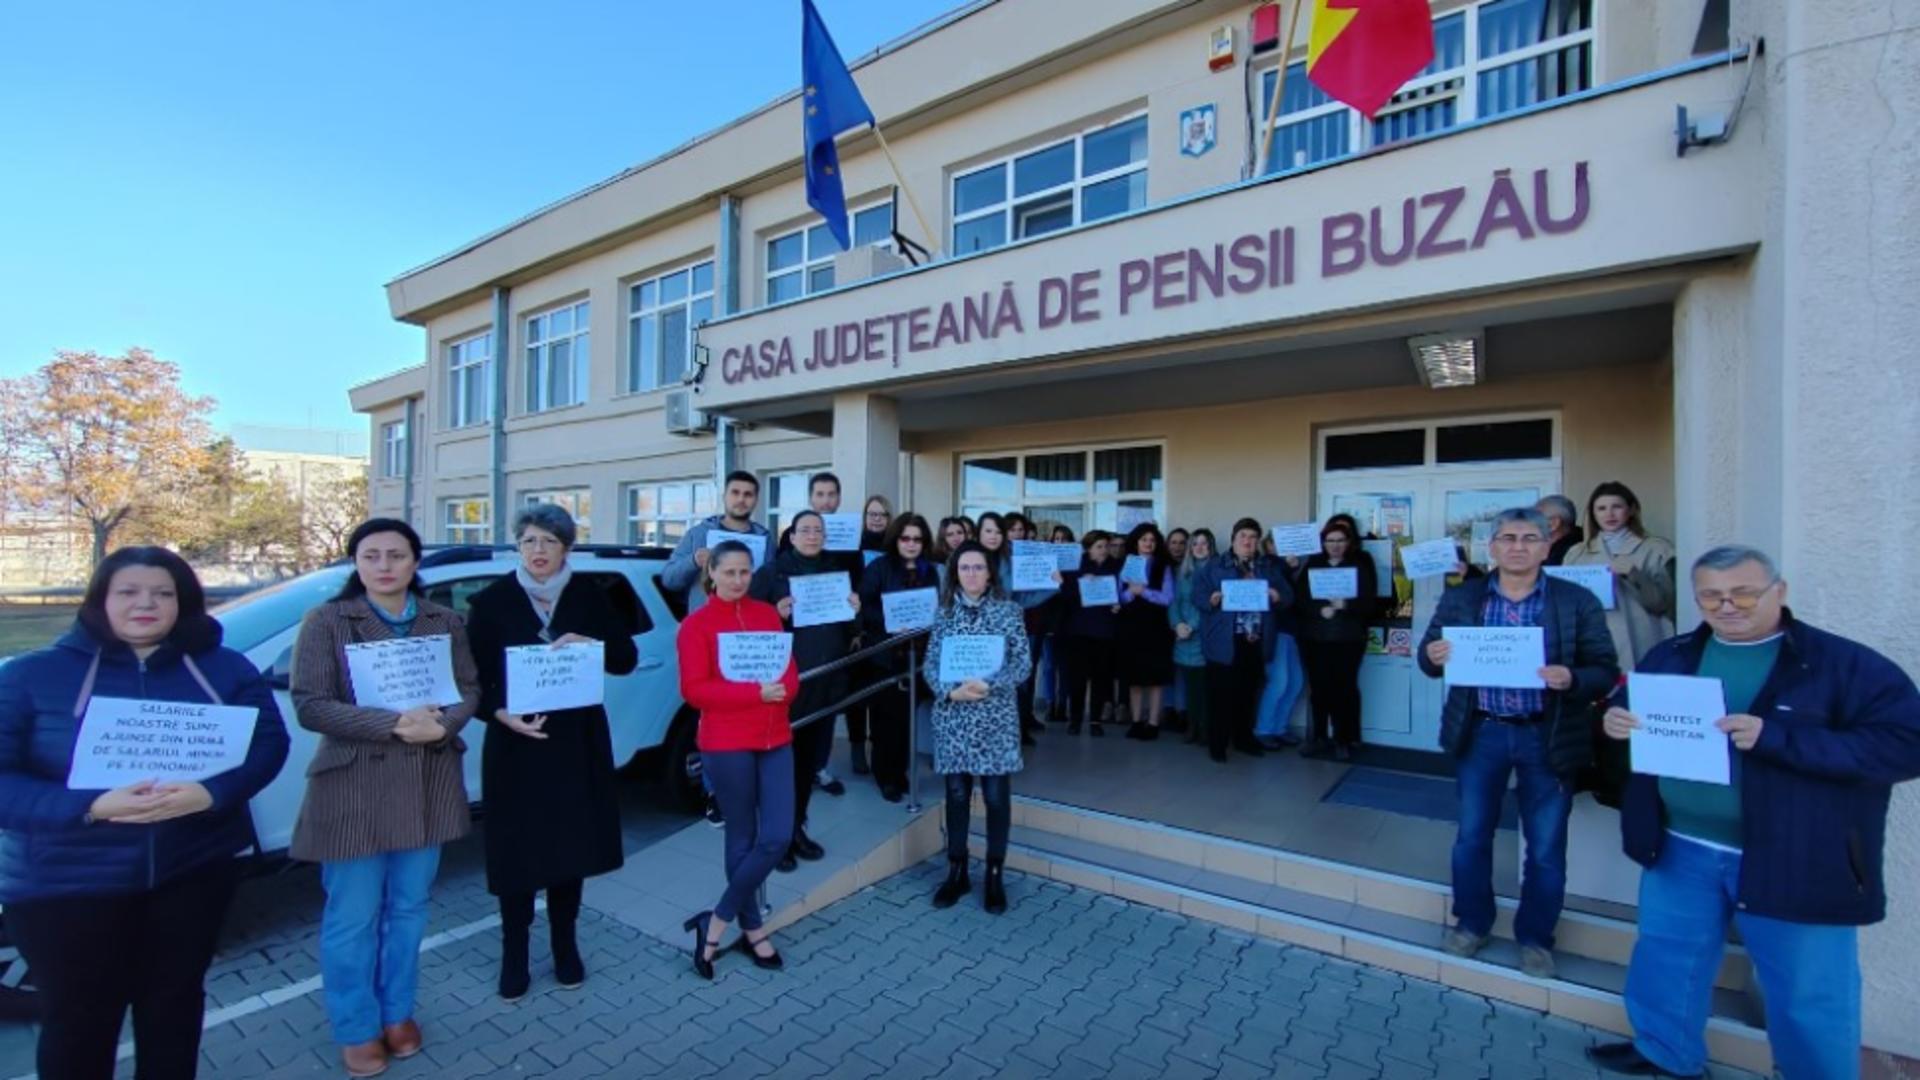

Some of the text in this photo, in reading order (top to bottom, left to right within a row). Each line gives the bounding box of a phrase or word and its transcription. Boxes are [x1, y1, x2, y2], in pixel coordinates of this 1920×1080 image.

[721, 160, 1591, 385] CASA JUDEȚEANĂ DE PENSII BUZĂU
[139, 703, 207, 717] SALARIILE
[115, 718, 220, 732] NOASTRE SUNT
[1646, 713, 1702, 726] PROTEST
[100, 731, 156, 743] AJUNSE
[159, 734, 183, 745] DIN
[1647, 727, 1705, 740] SPONTAN
[92, 745, 111, 756] DE
[117, 746, 179, 757] SALARIUL
[106, 759, 123, 770] PE
